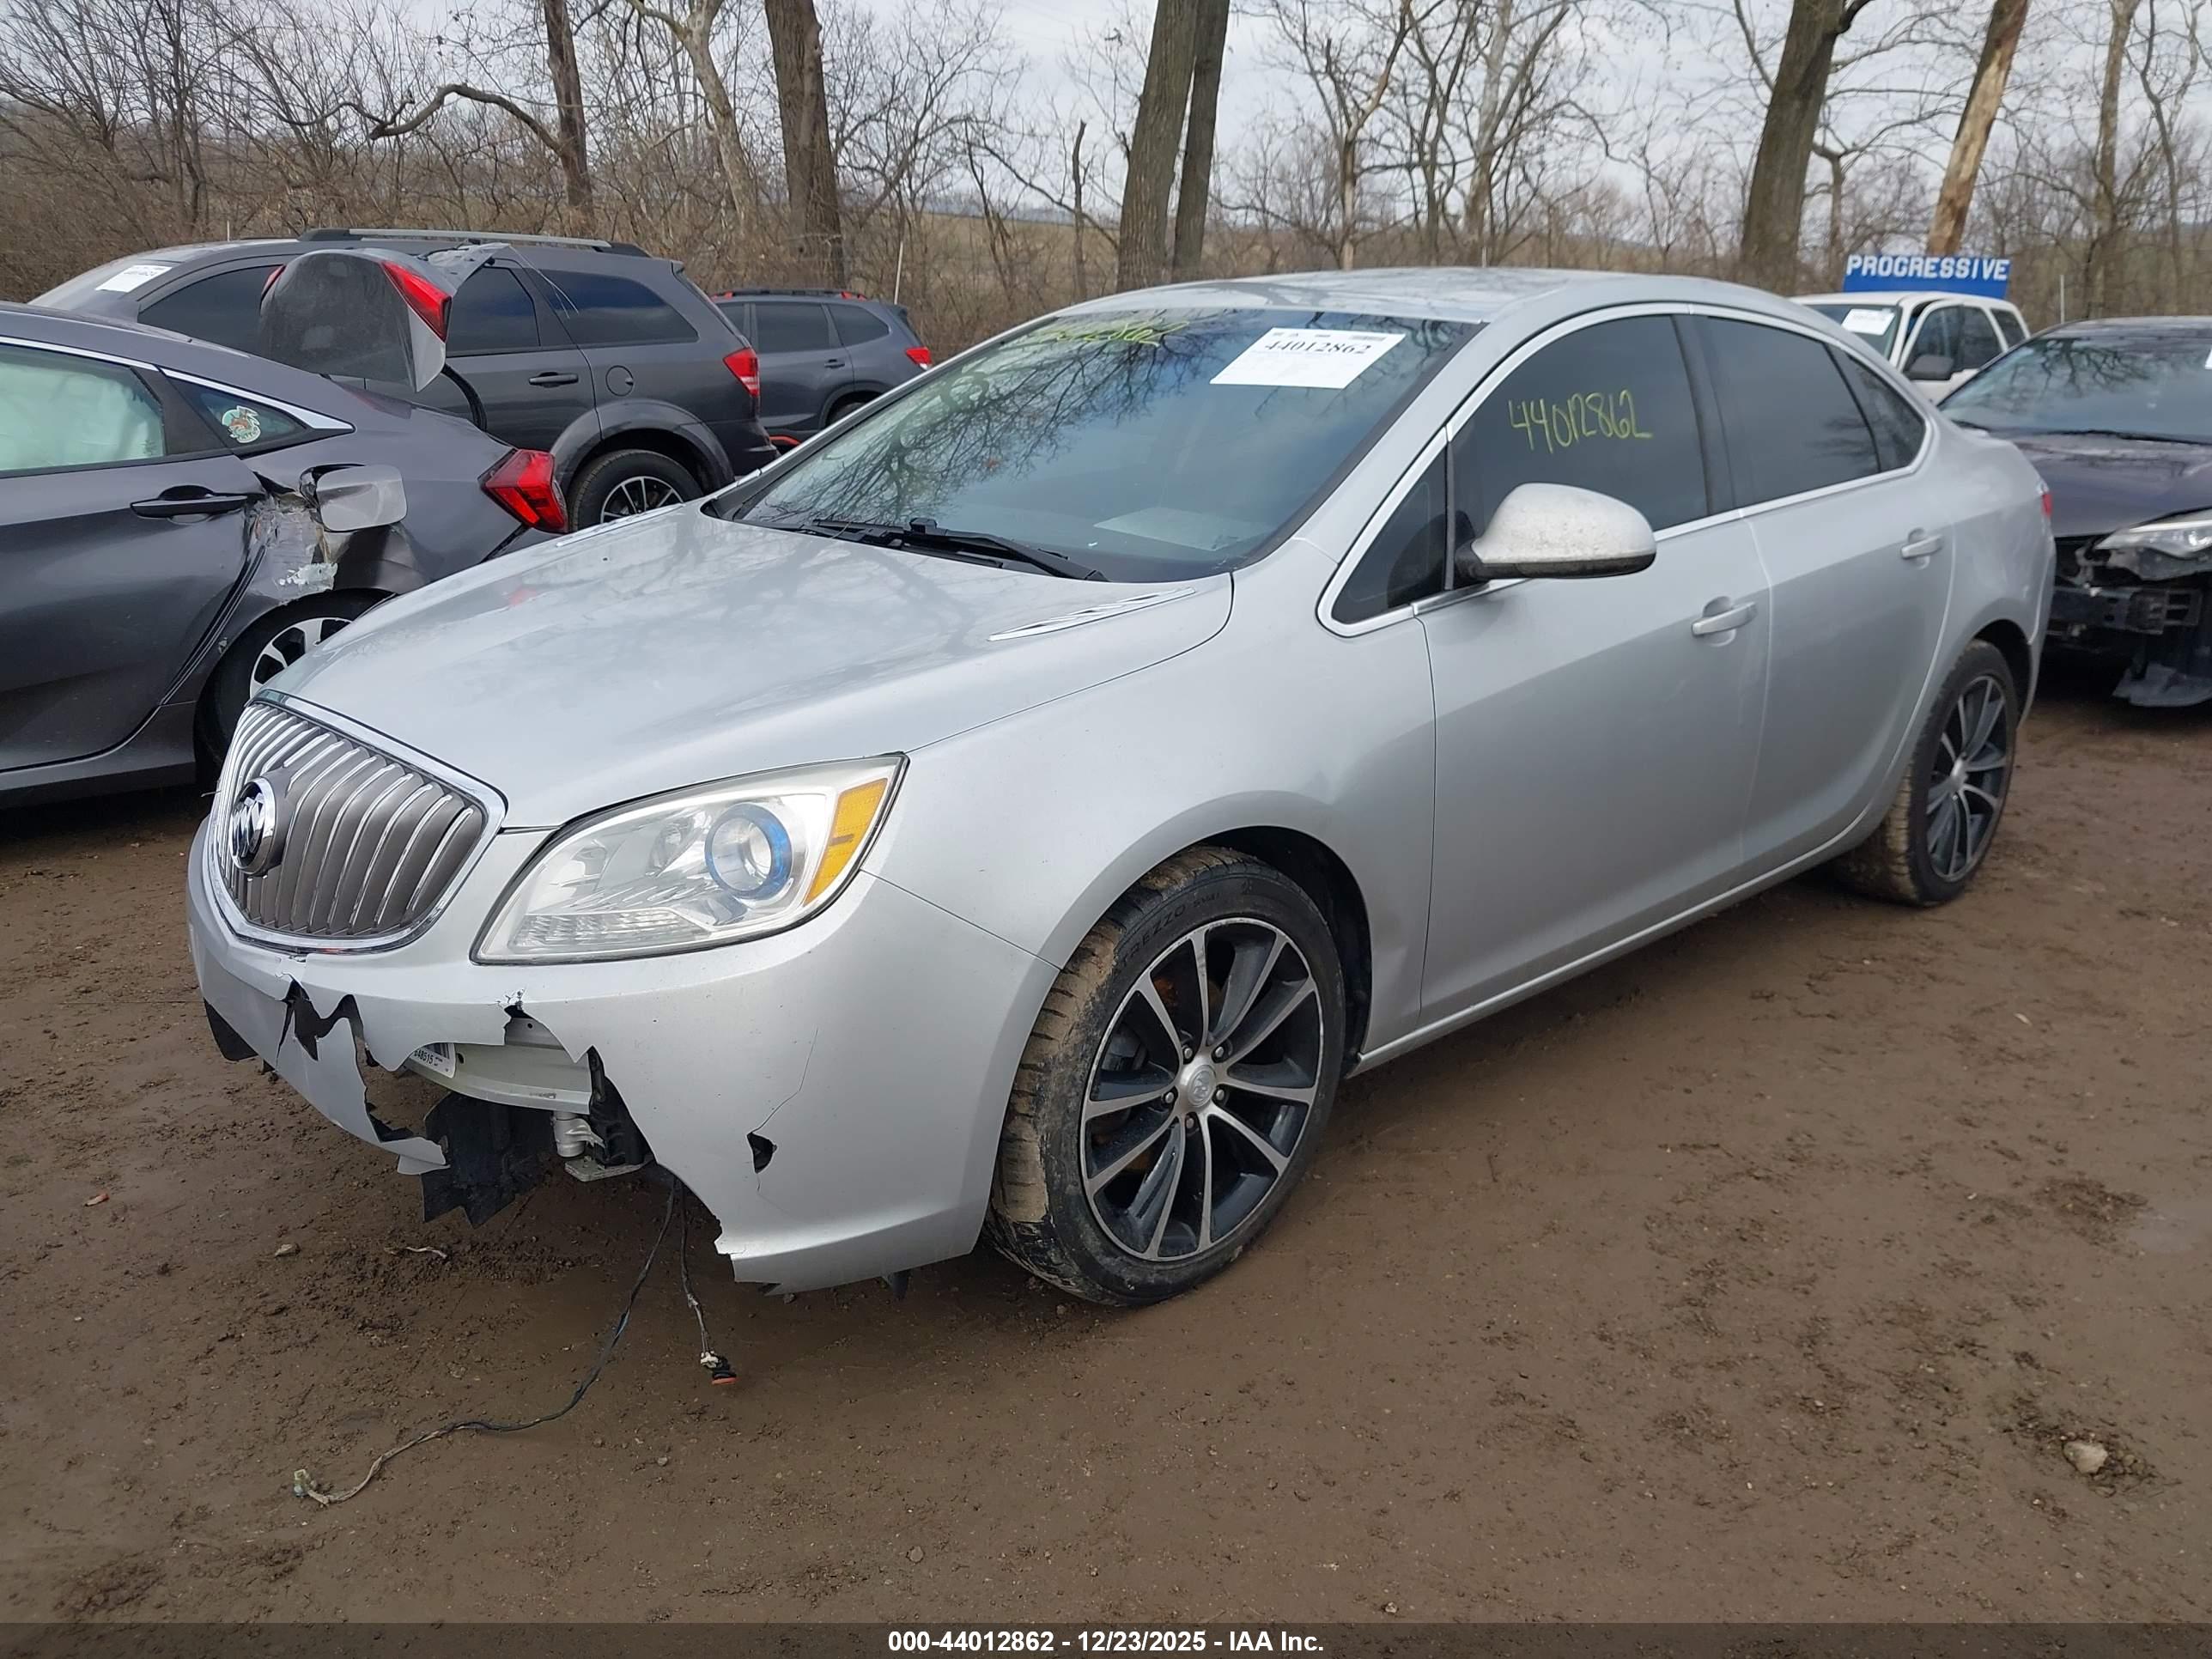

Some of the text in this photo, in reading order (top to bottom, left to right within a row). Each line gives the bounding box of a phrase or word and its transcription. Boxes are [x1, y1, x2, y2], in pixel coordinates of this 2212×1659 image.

[1846, 254, 2011, 282] PROGRESSIVE
[1264, 339, 1371, 355] 44012862
[1508, 389, 1653, 454] 44012862
